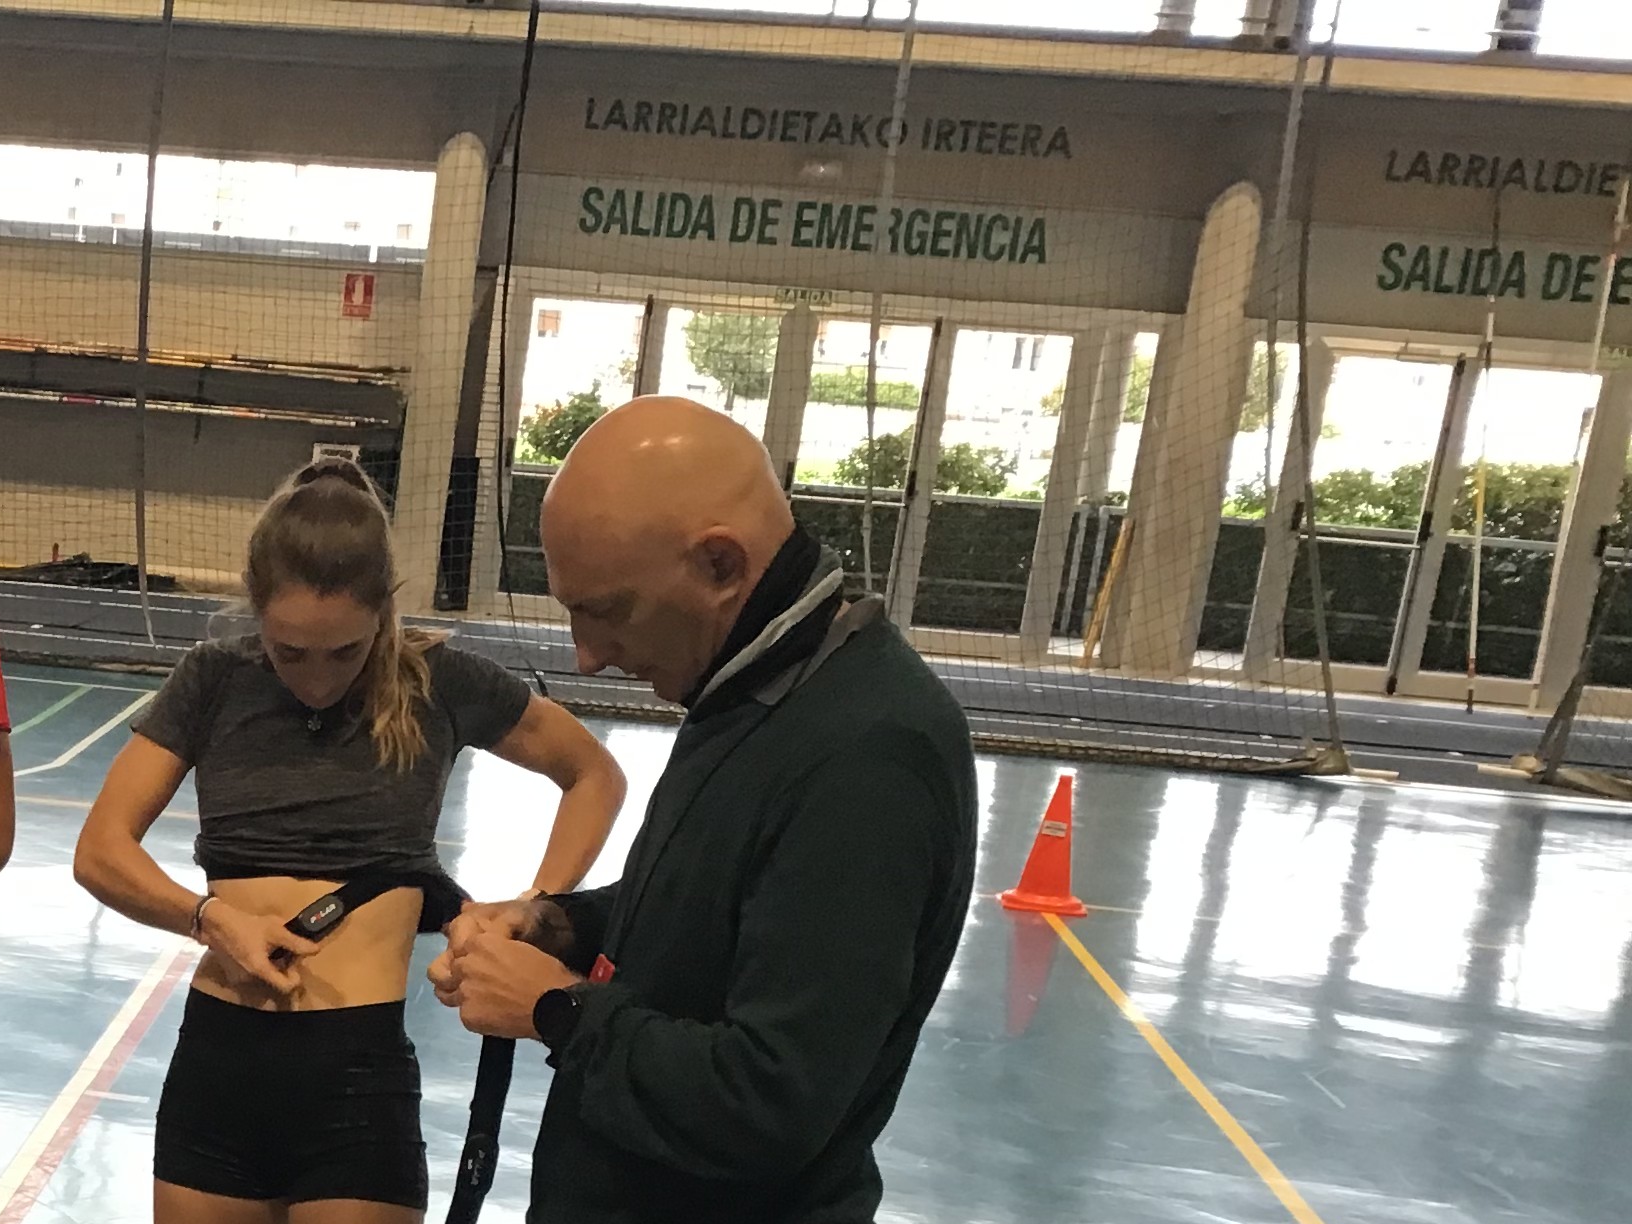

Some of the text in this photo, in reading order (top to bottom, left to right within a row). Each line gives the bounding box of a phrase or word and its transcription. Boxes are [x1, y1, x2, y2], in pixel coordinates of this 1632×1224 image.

[584, 98, 1072, 160] LARRIALDIETAKO IRTEERA
[577, 186, 716, 242] SALIDA
[729, 197, 782, 246] DE
[1377, 242, 1525, 298] SALIDA
[1542, 252, 1601, 303] DE
